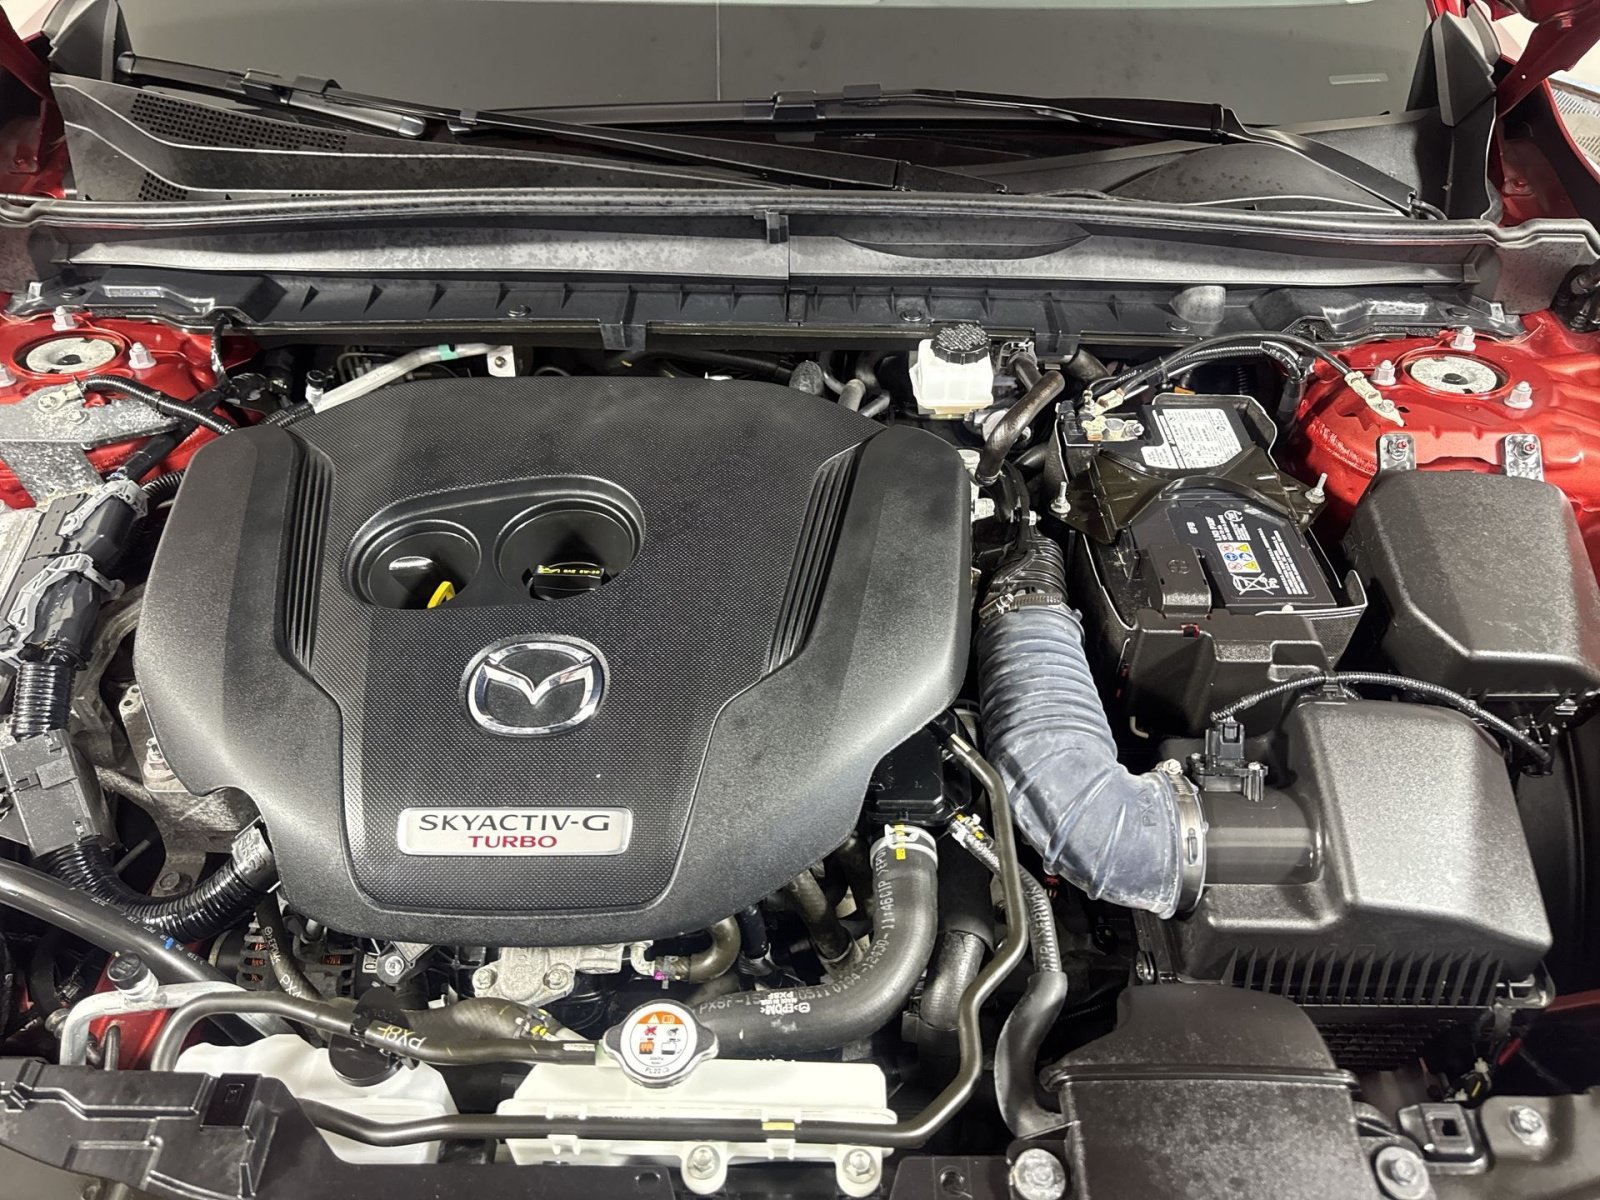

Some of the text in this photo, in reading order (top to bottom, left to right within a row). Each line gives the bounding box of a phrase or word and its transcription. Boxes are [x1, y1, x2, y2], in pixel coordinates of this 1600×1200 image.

[418, 814, 611, 832] SKYACTIV-G
[468, 835, 558, 849] TURBO
[377, 1025, 425, 1051] PX8F
